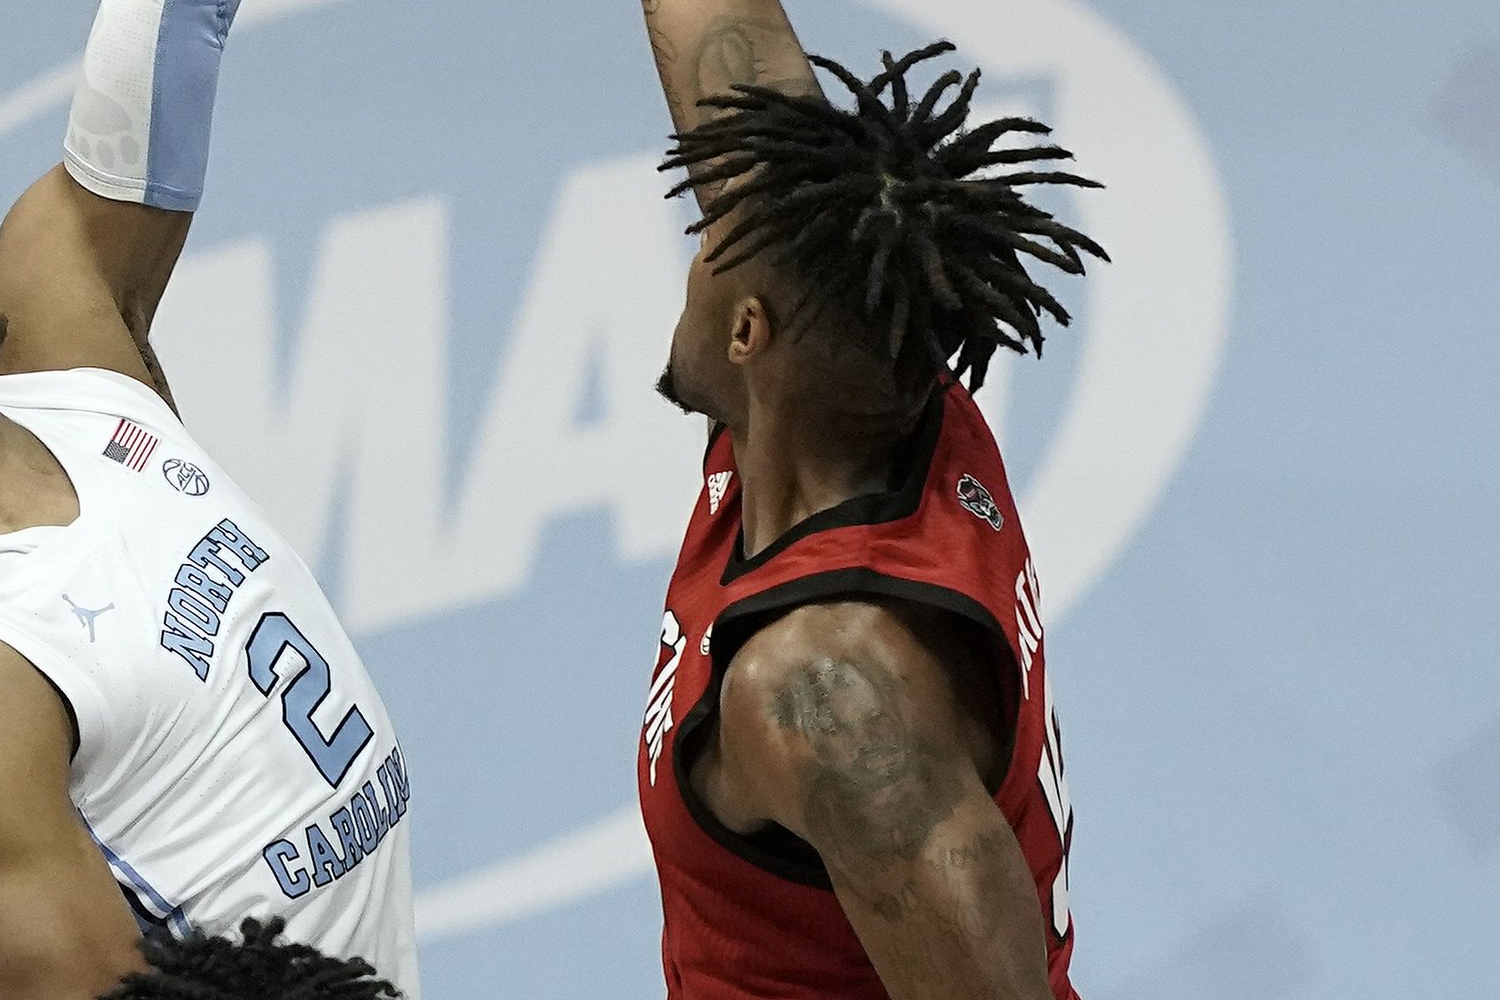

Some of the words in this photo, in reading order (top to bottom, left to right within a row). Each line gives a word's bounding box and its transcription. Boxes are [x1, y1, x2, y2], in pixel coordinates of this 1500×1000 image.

[161, 518, 270, 682] NORTH
[245, 612, 374, 789] 2
[263, 746, 411, 899] CAROLIN
